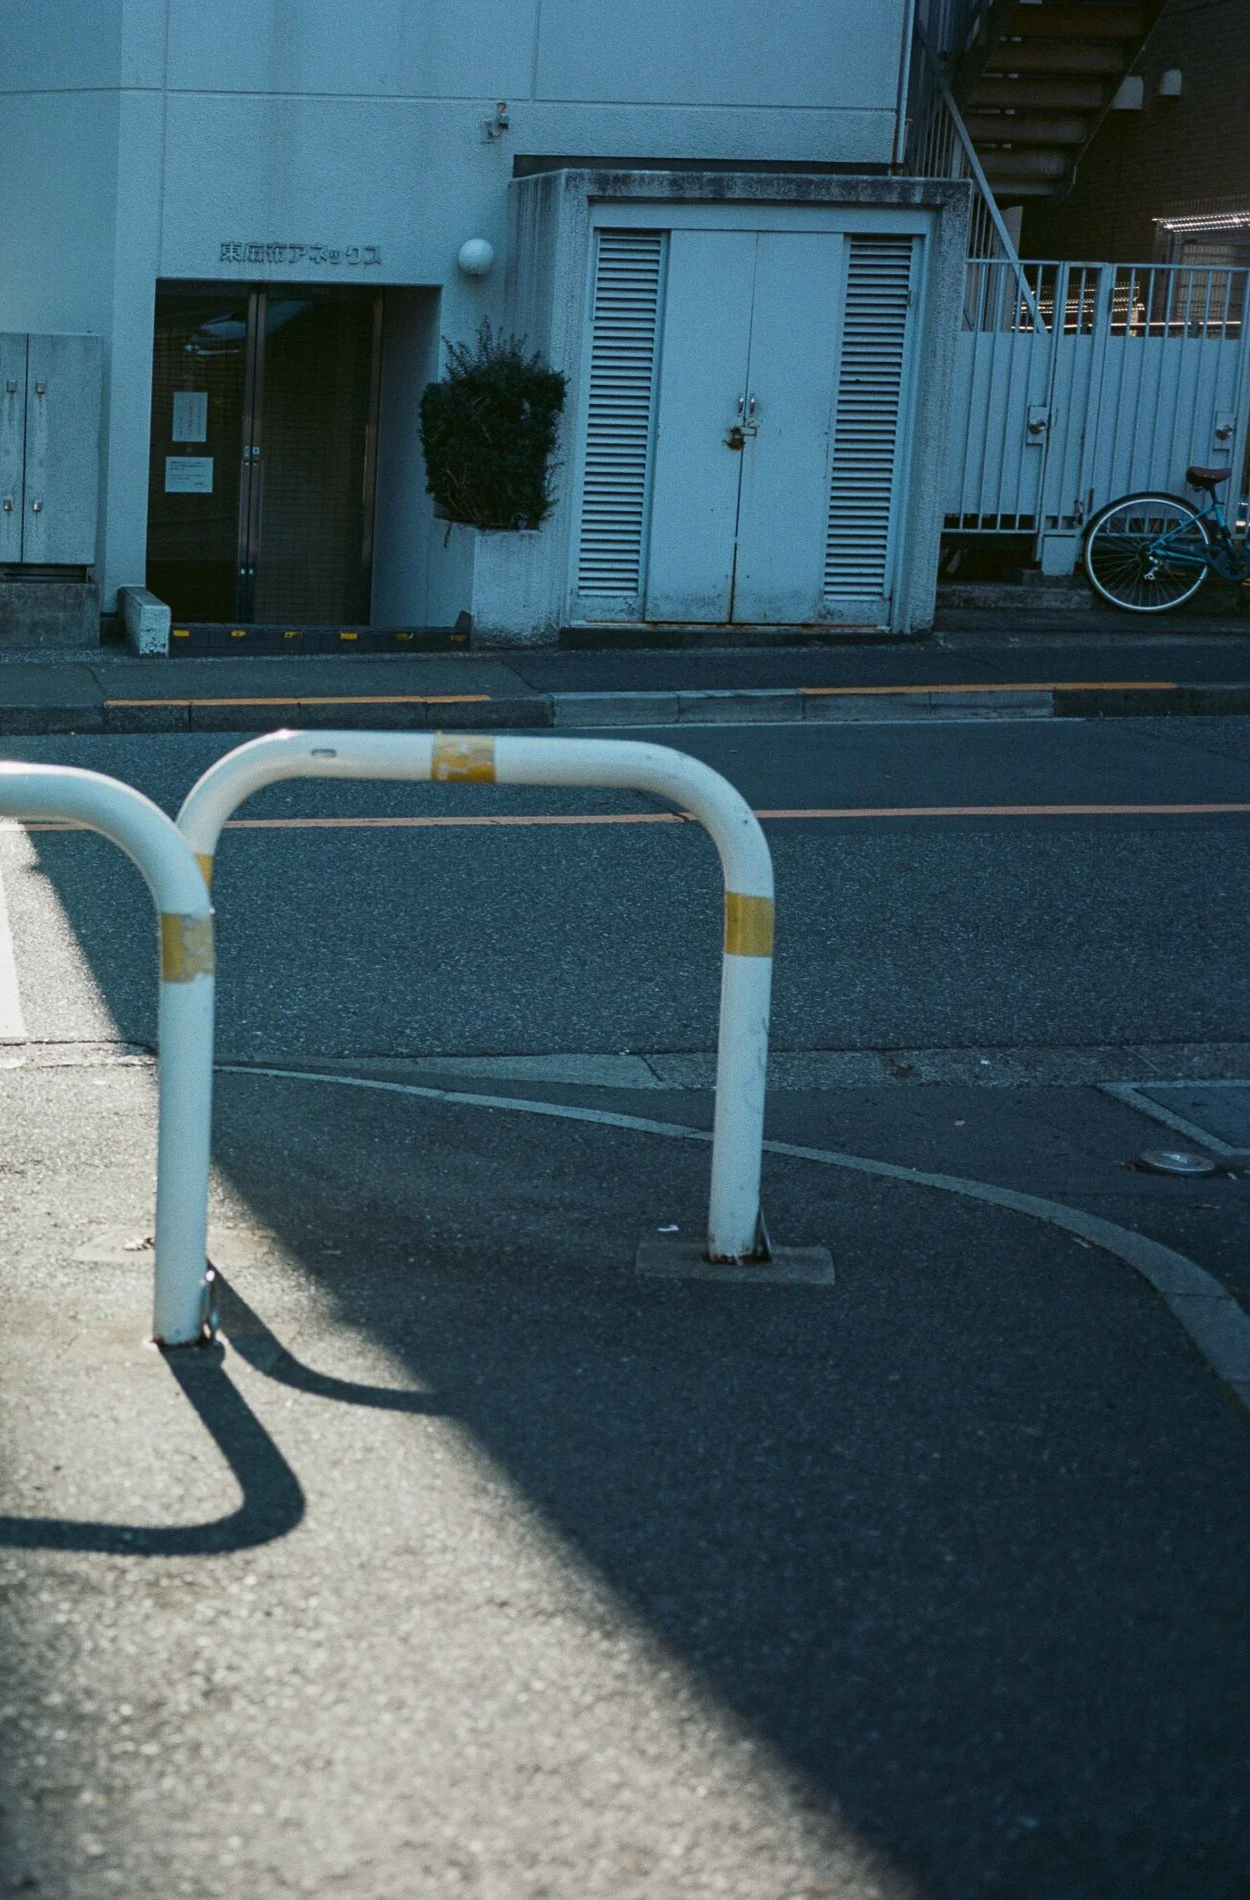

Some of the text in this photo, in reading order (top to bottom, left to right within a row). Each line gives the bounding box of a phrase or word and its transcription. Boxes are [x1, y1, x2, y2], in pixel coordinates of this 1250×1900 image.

[220, 242, 382, 265] 東麻布アネックス
